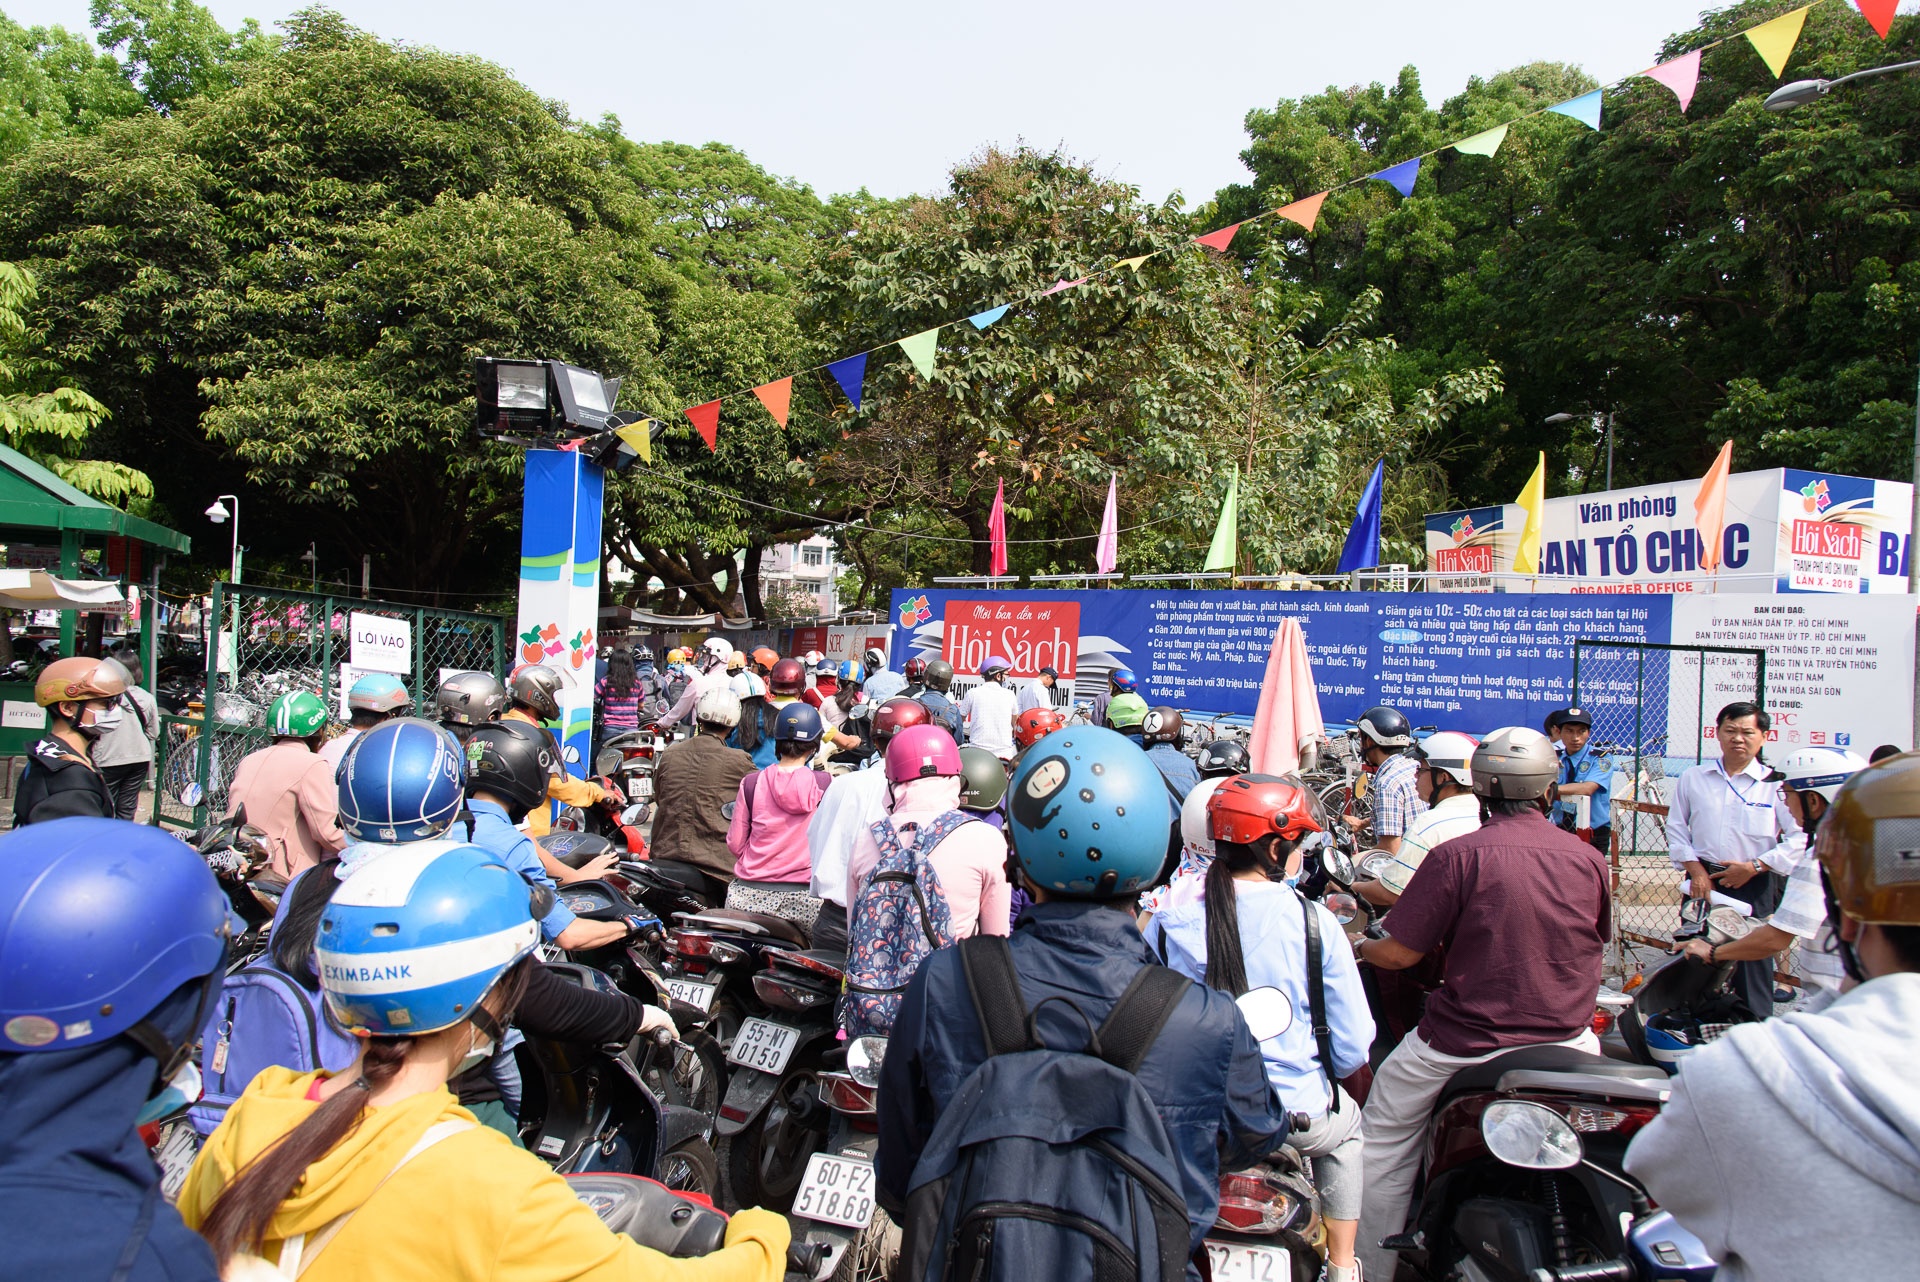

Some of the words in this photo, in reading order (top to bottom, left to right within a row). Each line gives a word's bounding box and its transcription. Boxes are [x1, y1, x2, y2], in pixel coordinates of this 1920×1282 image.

[1580, 503, 1612, 524] Văn
[1618, 495, 1676, 522] phòng
[1795, 522, 1820, 555] Hội
[1822, 524, 1859, 558] Sách
[1594, 525, 1638, 576] TỔ
[1646, 523, 1750, 574] CHC
[1460, 548, 1490, 573] Sách
[1570, 584, 1643, 594] ORGANIZER
[1646, 581, 1694, 593] OFFICE
[1817, 577, 1824, 586] X
[1832, 578, 1853, 589] 2018
[1156, 600, 1168, 610] Hội
[1260, 602, 1278, 612] phát
[1280, 602, 1298, 612] hành
[1324, 602, 1342, 612] kinh
[1344, 603, 1370, 612] doanh
[1386, 605, 1406, 616] Giảm
[1409, 606, 1422, 618] giá
[1435, 604, 1454, 617] 10%
[1464, 604, 1482, 617] 50%
[1484, 607, 1500, 618] cho
[1518, 606, 1528, 618] cả
[1531, 608, 1548, 618] các
[1550, 608, 1568, 620] loại
[1570, 608, 1592, 618] sách
[1596, 608, 1614, 619] bán
[1616, 608, 1629, 620] tại
[1632, 608, 1648, 620] Hội
[1170, 612, 1192, 623] phòng
[1215, 612, 1234, 624] trong
[1256, 613, 1266, 622] và
[1724, 618, 1740, 627] BAN
[1812, 617, 1826, 628] CHÍ
[1828, 620, 1849, 628] MINH
[1170, 624, 1183, 635] 200
[1207, 626, 1226, 636] tham
[1228, 627, 1238, 638] gia
[1254, 627, 1268, 637] 900
[1384, 618, 1404, 628] sách
[1408, 619, 1418, 628] và
[1422, 618, 1446, 629] nhiều
[1450, 619, 1466, 632] quà
[1470, 620, 1490, 632] tặng
[1493, 619, 1510, 633] hấp
[1535, 620, 1558, 632] dành
[1562, 622, 1580, 632] cho
[1584, 622, 1614, 633] khách
[1619, 622, 1647, 636] hàng.
[828, 634, 844, 652] SCPC
[1424, 632, 1446, 644] trong
[1448, 632, 1454, 642] 3
[1456, 632, 1478, 645] ngày
[1500, 633, 1518, 644] của
[1520, 634, 1534, 646] Hội
[1536, 634, 1562, 645] sách:
[1696, 631, 1711, 640] BAN
[1828, 631, 1843, 642] CHÍ
[1844, 634, 1866, 642] MINH
[1001, 625, 1071, 674] Sách
[1154, 638, 1163, 648] Có
[1174, 640, 1192, 649] tham
[1194, 640, 1204, 651] gia
[1236, 641, 1246, 650] 40
[1247, 642, 1262, 651] Nhà
[1318, 644, 1340, 656] ngoài
[1342, 644, 1357, 654] đến
[1384, 643, 1394, 653] có
[1428, 645, 1463, 658] chương
[1468, 646, 1490, 656] trình
[1496, 646, 1511, 659] giá
[1516, 647, 1540, 658] sách
[1546, 648, 1564, 660] đặc
[1594, 648, 1620, 660] dành
[1840, 645, 1854, 656] CHÍ
[1856, 648, 1878, 656] MINH
[1152, 661, 1166, 671] Ban
[1154, 650, 1166, 659] các
[1352, 656, 1367, 670] Tây
[1382, 655, 1410, 666] khách
[1412, 656, 1438, 670] hàng.
[1788, 659, 1800, 668] TIN
[1186, 676, 1203, 686] sách
[1216, 678, 1225, 688] 30
[1244, 678, 1258, 689] bản
[1318, 682, 1333, 696] bày
[1345, 684, 1365, 696] phục
[1382, 670, 1402, 684] Hàng
[1405, 672, 1424, 682] trăm
[1428, 673, 1458, 686] chương
[1461, 674, 1482, 684] trình
[1484, 675, 1504, 687] hoạt
[1506, 676, 1528, 689] động
[1531, 676, 1545, 688] sôi
[1806, 674, 1824, 682] NAM
[1160, 686, 1172, 698] độc
[1382, 684, 1402, 694] chức
[1404, 684, 1414, 696] tại
[1416, 685, 1432, 696] sân
[1434, 686, 1456, 697] khấu
[1458, 687, 1482, 700] trung
[1506, 688, 1524, 700] Nhà
[1526, 690, 1541, 702] hội
[1544, 690, 1564, 702] thảo
[1380, 696, 1396, 706] các
[1397, 697, 1412, 708] đơn
[1414, 698, 1422, 710] vị
[1423, 698, 1444, 710] tham
[1446, 700, 1462, 712] gia.
[308, 708, 326, 726] Grab
[324, 964, 412, 982] EXIMBANK
[670, 983, 704, 1004] 59-K1
[746, 1022, 789, 1048] 55-N1
[842, 1148, 868, 1158] HONDA
[816, 1160, 872, 1193] 60-F2
[800, 1186, 870, 1222] 518.68
